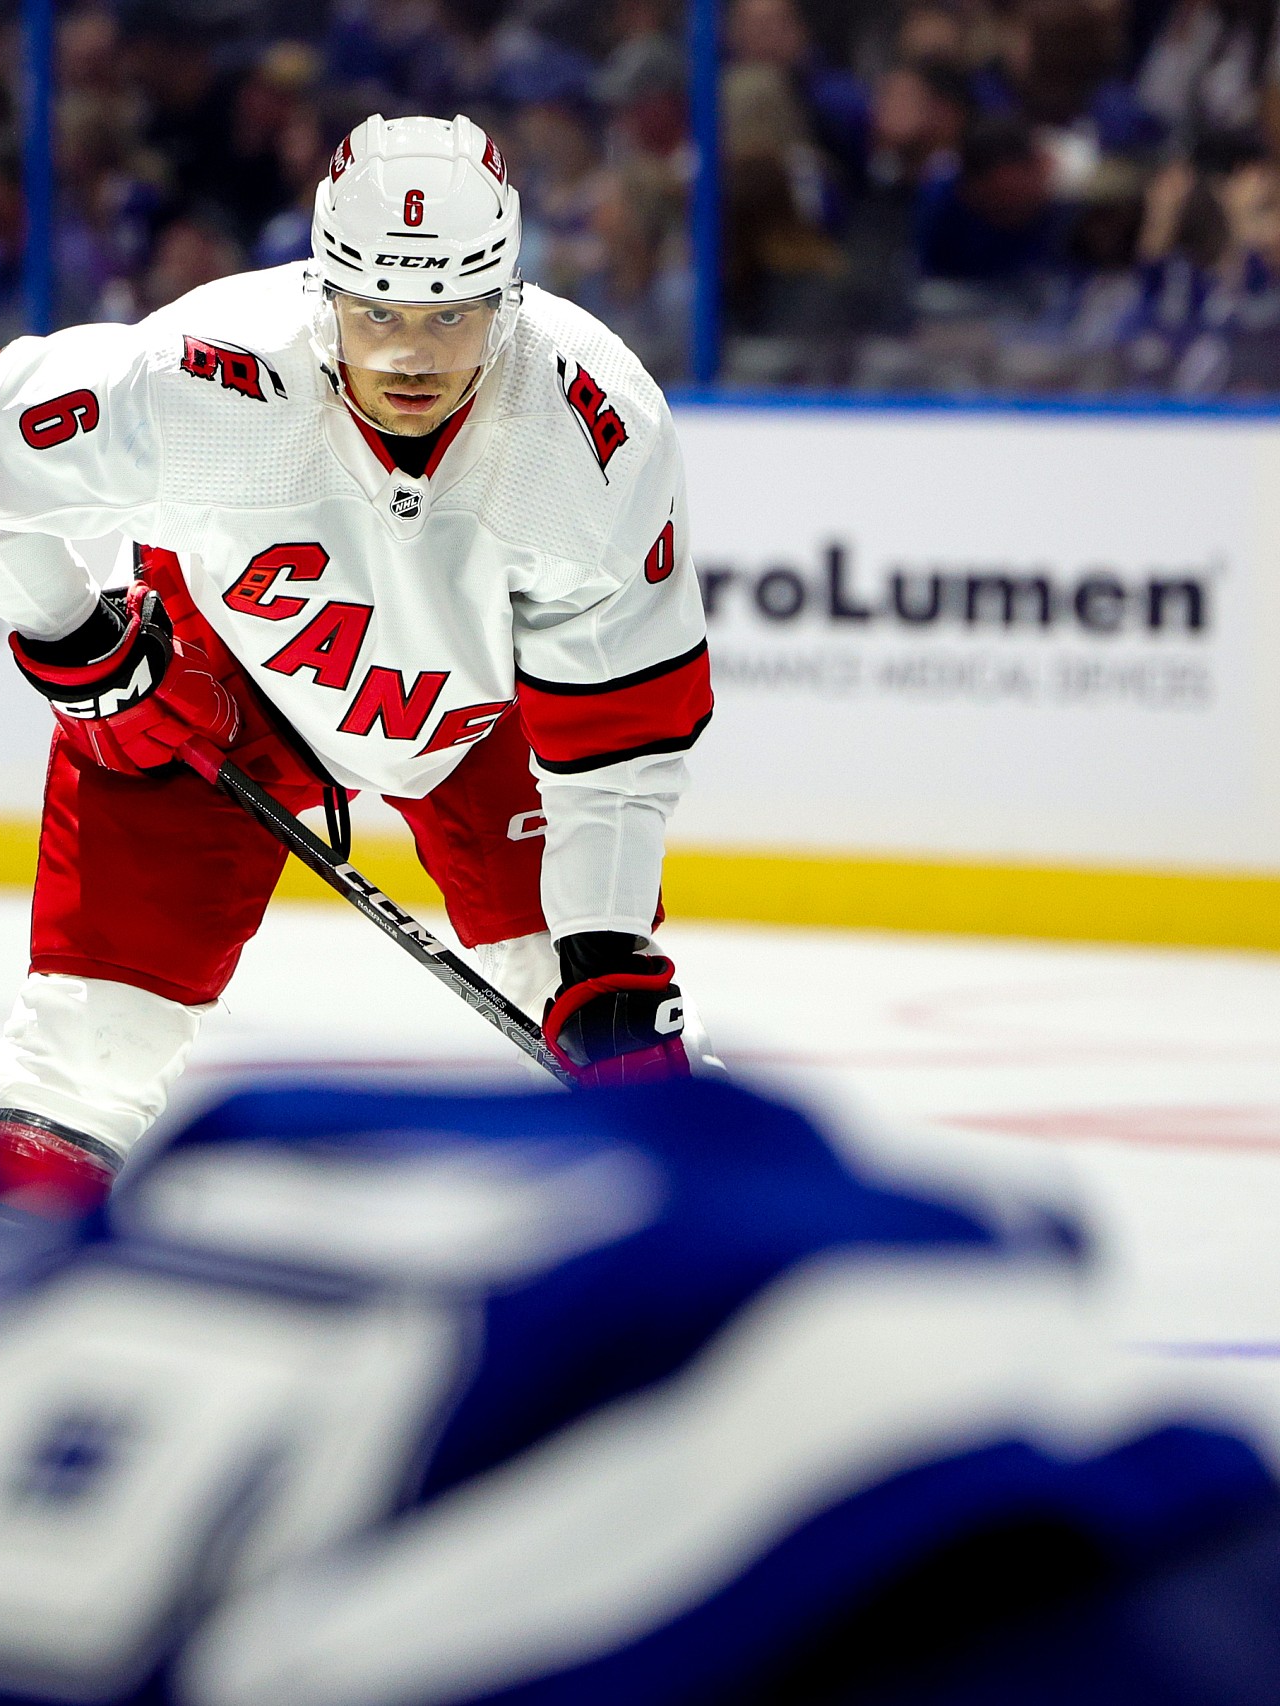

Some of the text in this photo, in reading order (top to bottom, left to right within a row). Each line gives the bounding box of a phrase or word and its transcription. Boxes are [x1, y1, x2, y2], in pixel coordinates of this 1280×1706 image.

[403, 189, 425, 227] 6
[374, 253, 450, 269] CCM
[19, 388, 100, 450] 6
[395, 498, 418, 513] NHL
[222, 541, 516, 760] CANE
[335, 862, 449, 956] CCM
[481, 987, 507, 1009] JONES
